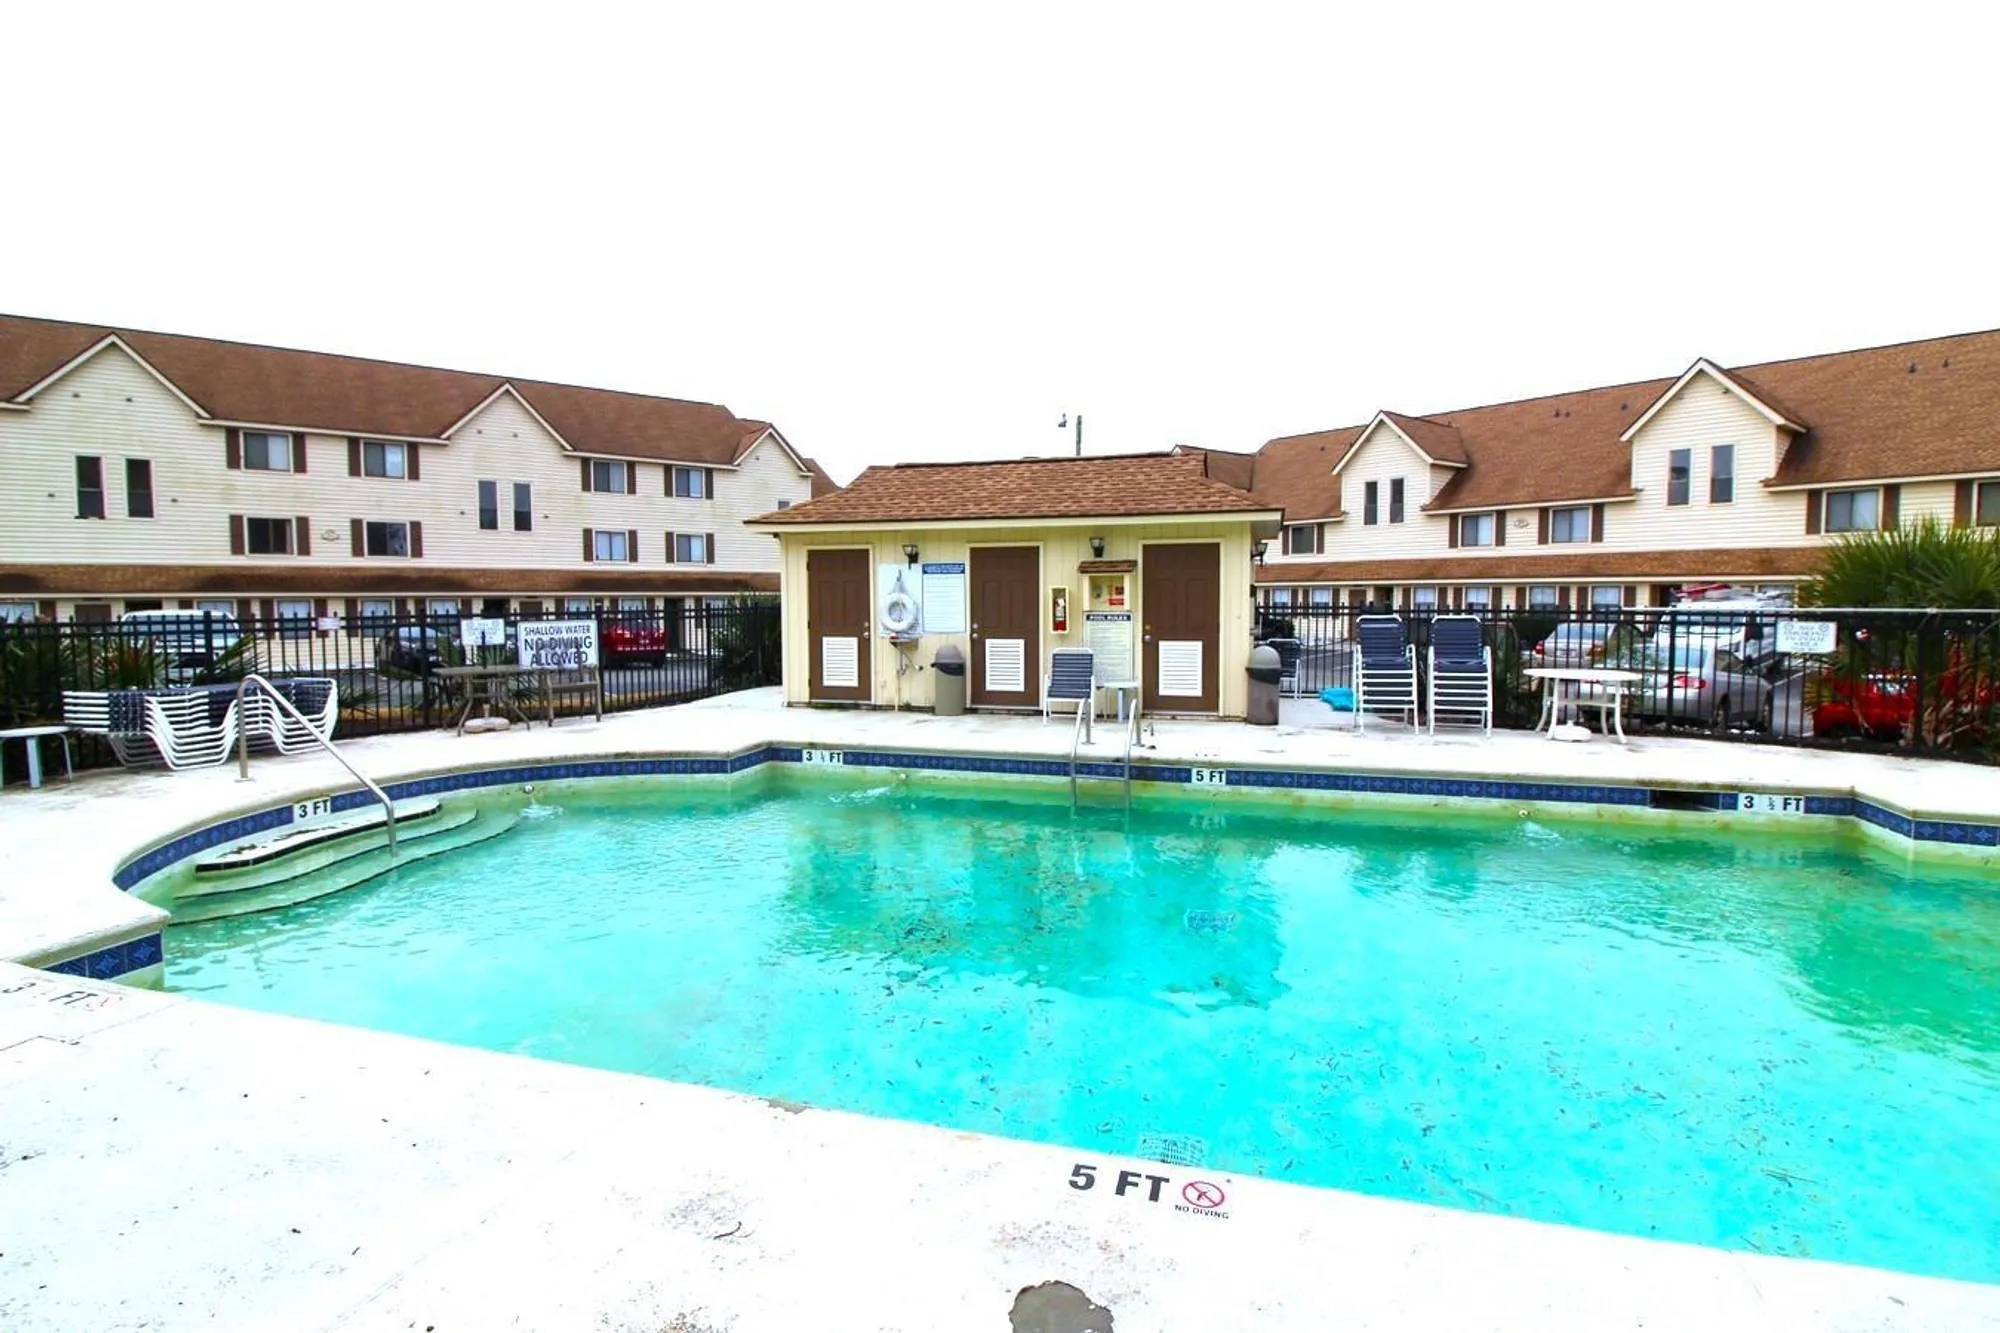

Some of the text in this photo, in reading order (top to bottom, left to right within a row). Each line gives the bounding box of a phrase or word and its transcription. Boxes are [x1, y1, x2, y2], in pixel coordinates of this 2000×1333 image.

[524, 625, 591, 635] SHALLOW WATER
[524, 637, 592, 651] NO DIVING
[530, 651, 588, 667] ALLOWED
[806, 751, 813, 761] 3
[830, 752, 841, 763] FT
[1196, 770, 1224, 783] 5 FT
[299, 799, 329, 818] 3 FT
[1743, 795, 1754, 809] 3
[1783, 797, 1802, 811] FT
[1068, 1163, 1170, 1202] 5 FT
[1174, 1204, 1229, 1219] NO DIVING
